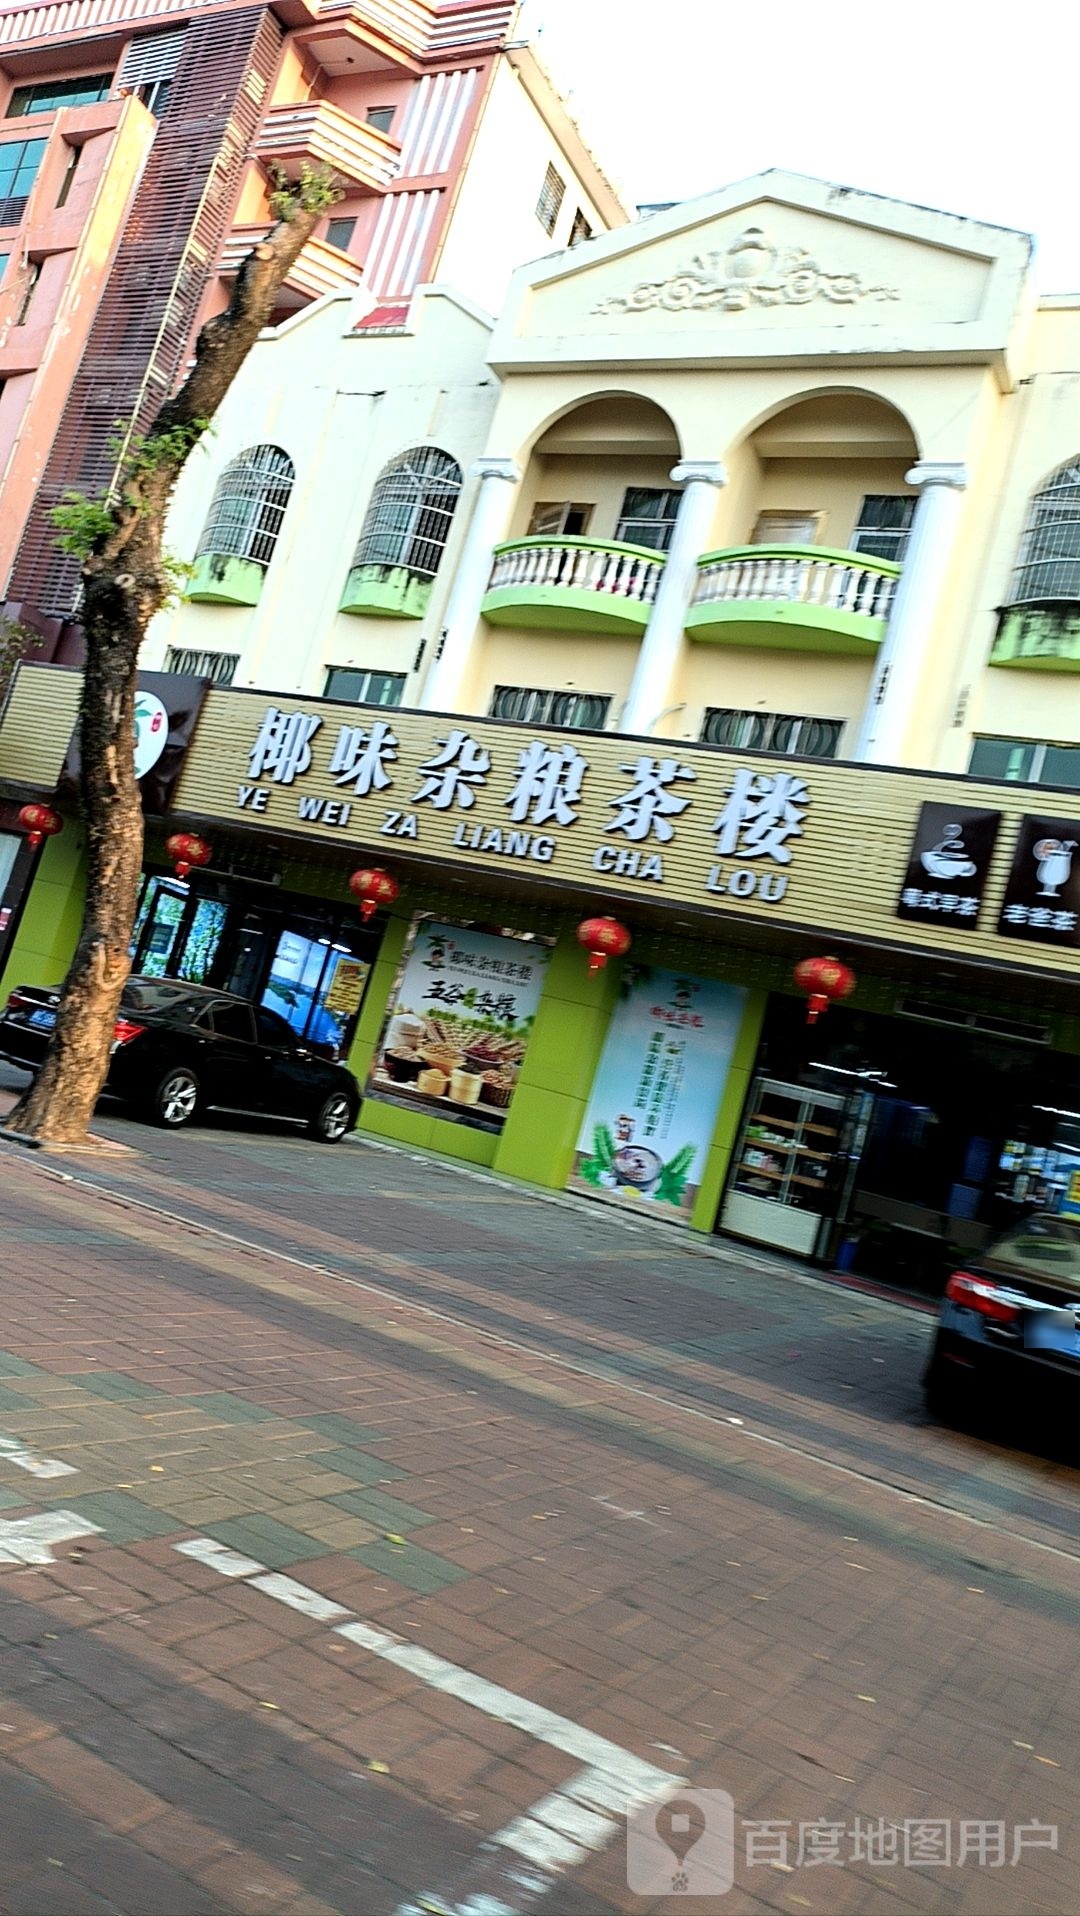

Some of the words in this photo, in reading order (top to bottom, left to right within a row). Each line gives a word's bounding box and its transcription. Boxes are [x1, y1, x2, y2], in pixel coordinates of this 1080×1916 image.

[237, 785, 270, 813] YE
[299, 797, 351, 826] WEI
[379, 810, 418, 839] ZA
[452, 822, 556, 863] LIANG
[592, 846, 664, 882] CHA
[706, 864, 788, 902] LOU
[248, 705, 811, 865] 椰味杂粮茶楼
